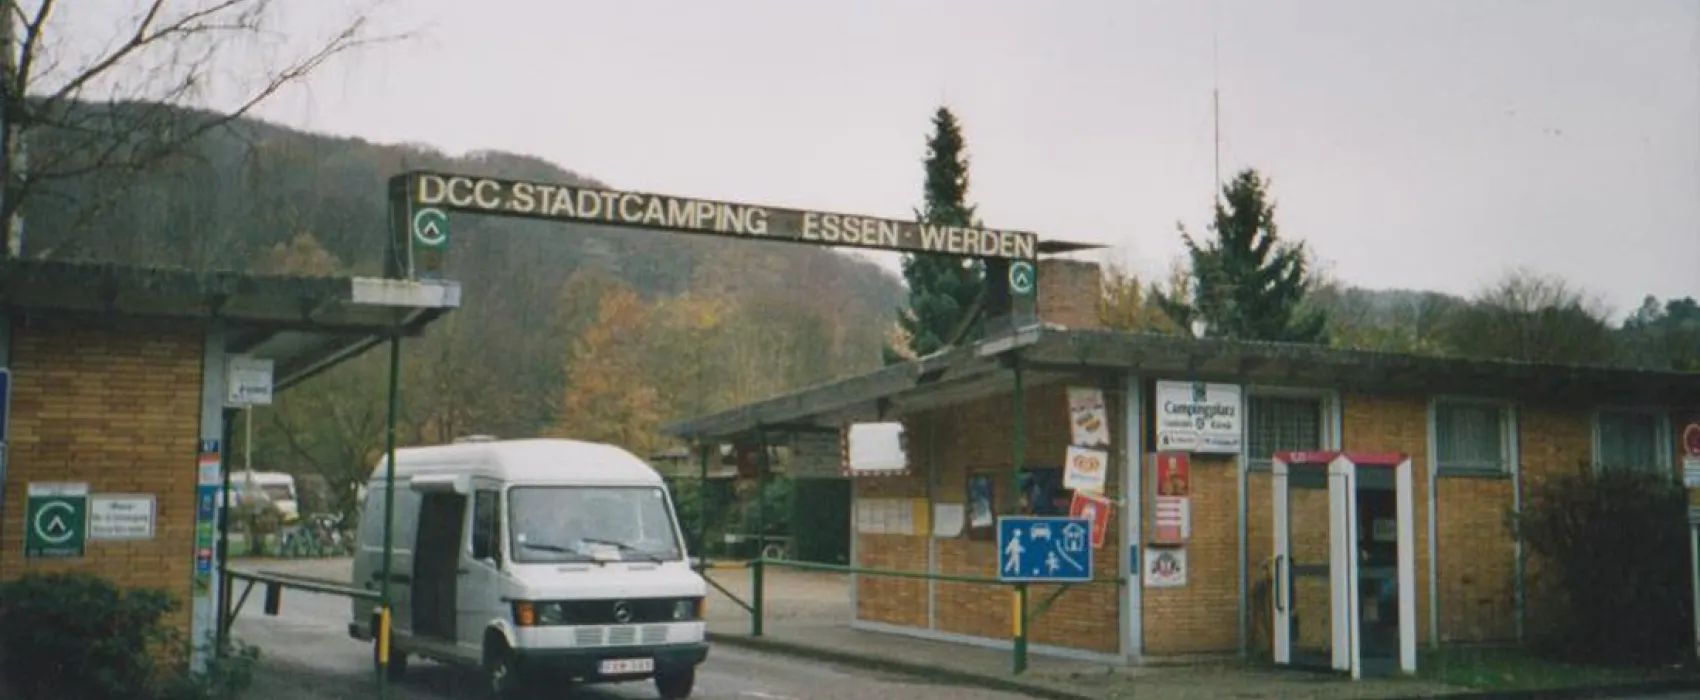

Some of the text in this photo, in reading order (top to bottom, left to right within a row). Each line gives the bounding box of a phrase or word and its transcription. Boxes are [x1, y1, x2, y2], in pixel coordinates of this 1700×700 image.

[419, 174, 1034, 260] DCC STADTCAMPING ESSEN WERDEN
[1164, 400, 1236, 420] Campingplatz
